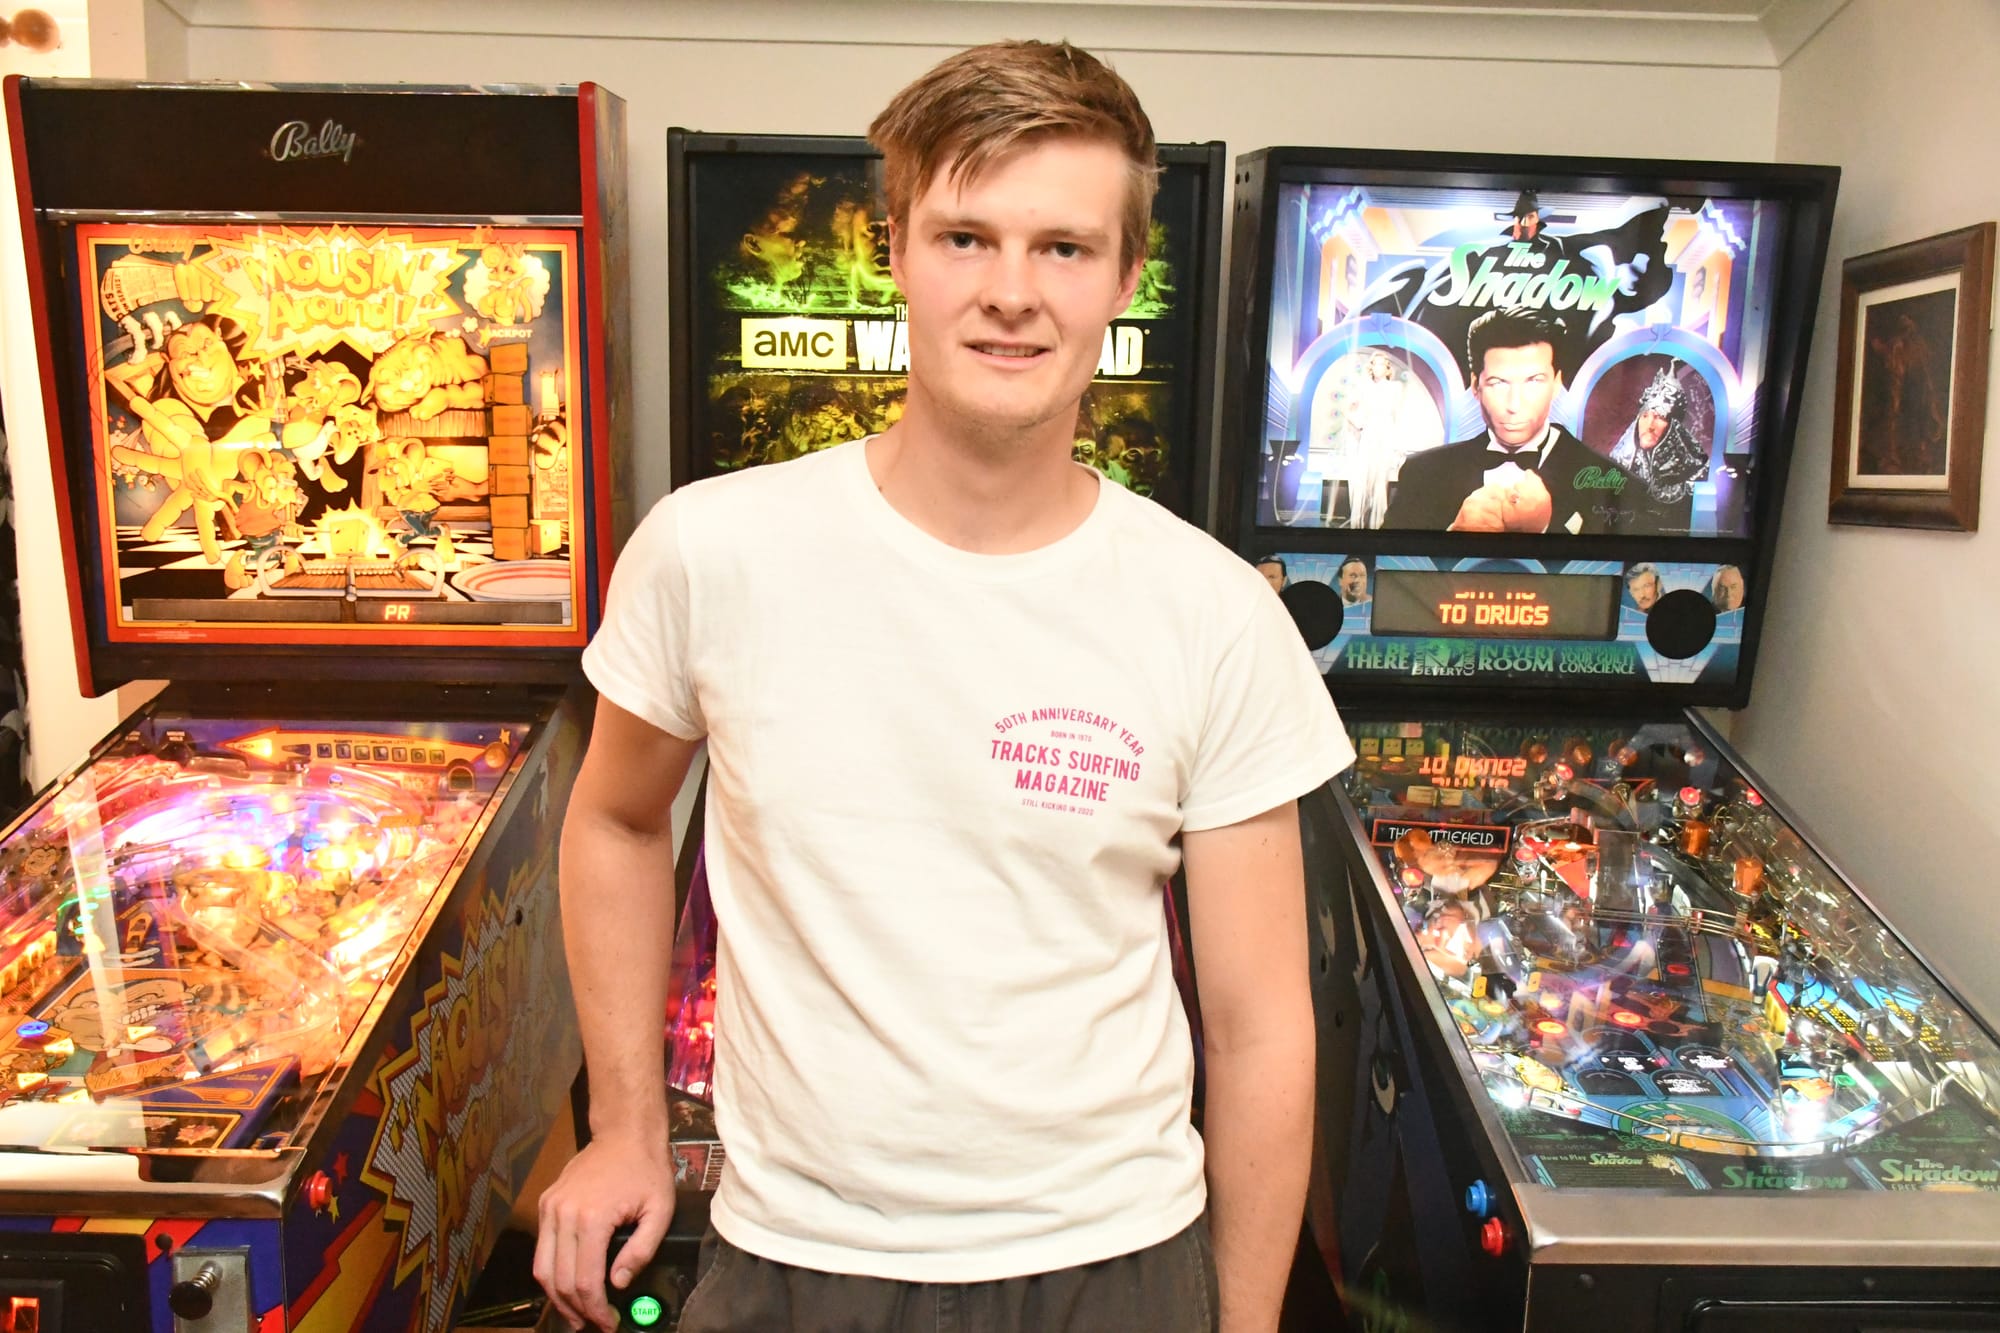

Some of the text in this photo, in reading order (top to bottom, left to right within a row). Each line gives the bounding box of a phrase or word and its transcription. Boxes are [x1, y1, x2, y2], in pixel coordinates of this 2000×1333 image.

[270, 119, 356, 163] Bally
[1504, 242, 1546, 269] The
[1427, 243, 1621, 311] Shadow
[1573, 466, 1628, 495] Bally
[384, 604, 412, 621] PR
[1439, 603, 1550, 626] TO DRUGS
[1479, 643, 1499, 658] IN
[1502, 643, 1556, 659] EVERY
[1346, 654, 1410, 670] THERE
[1478, 657, 1554, 672] ROOM
[1558, 662, 1636, 675] CONSCIENCE
[995, 707, 1145, 757] 50TH ANNIVERSARY YEAR
[1051, 730, 1067, 739] BORN
[991, 739, 1141, 781] TRACKS SURFING
[1015, 769, 1110, 802] MAGAZINE
[1022, 798, 1038, 808] STILL
[1041, 800, 1067, 812] KICKING
[1588, 1152, 1643, 1165] Shadow
[1914, 1159, 1944, 1169] The
[1721, 1165, 1849, 1189] Shadow
[1880, 1159, 1999, 1182] Shadow
[633, 1308, 657, 1316] START
